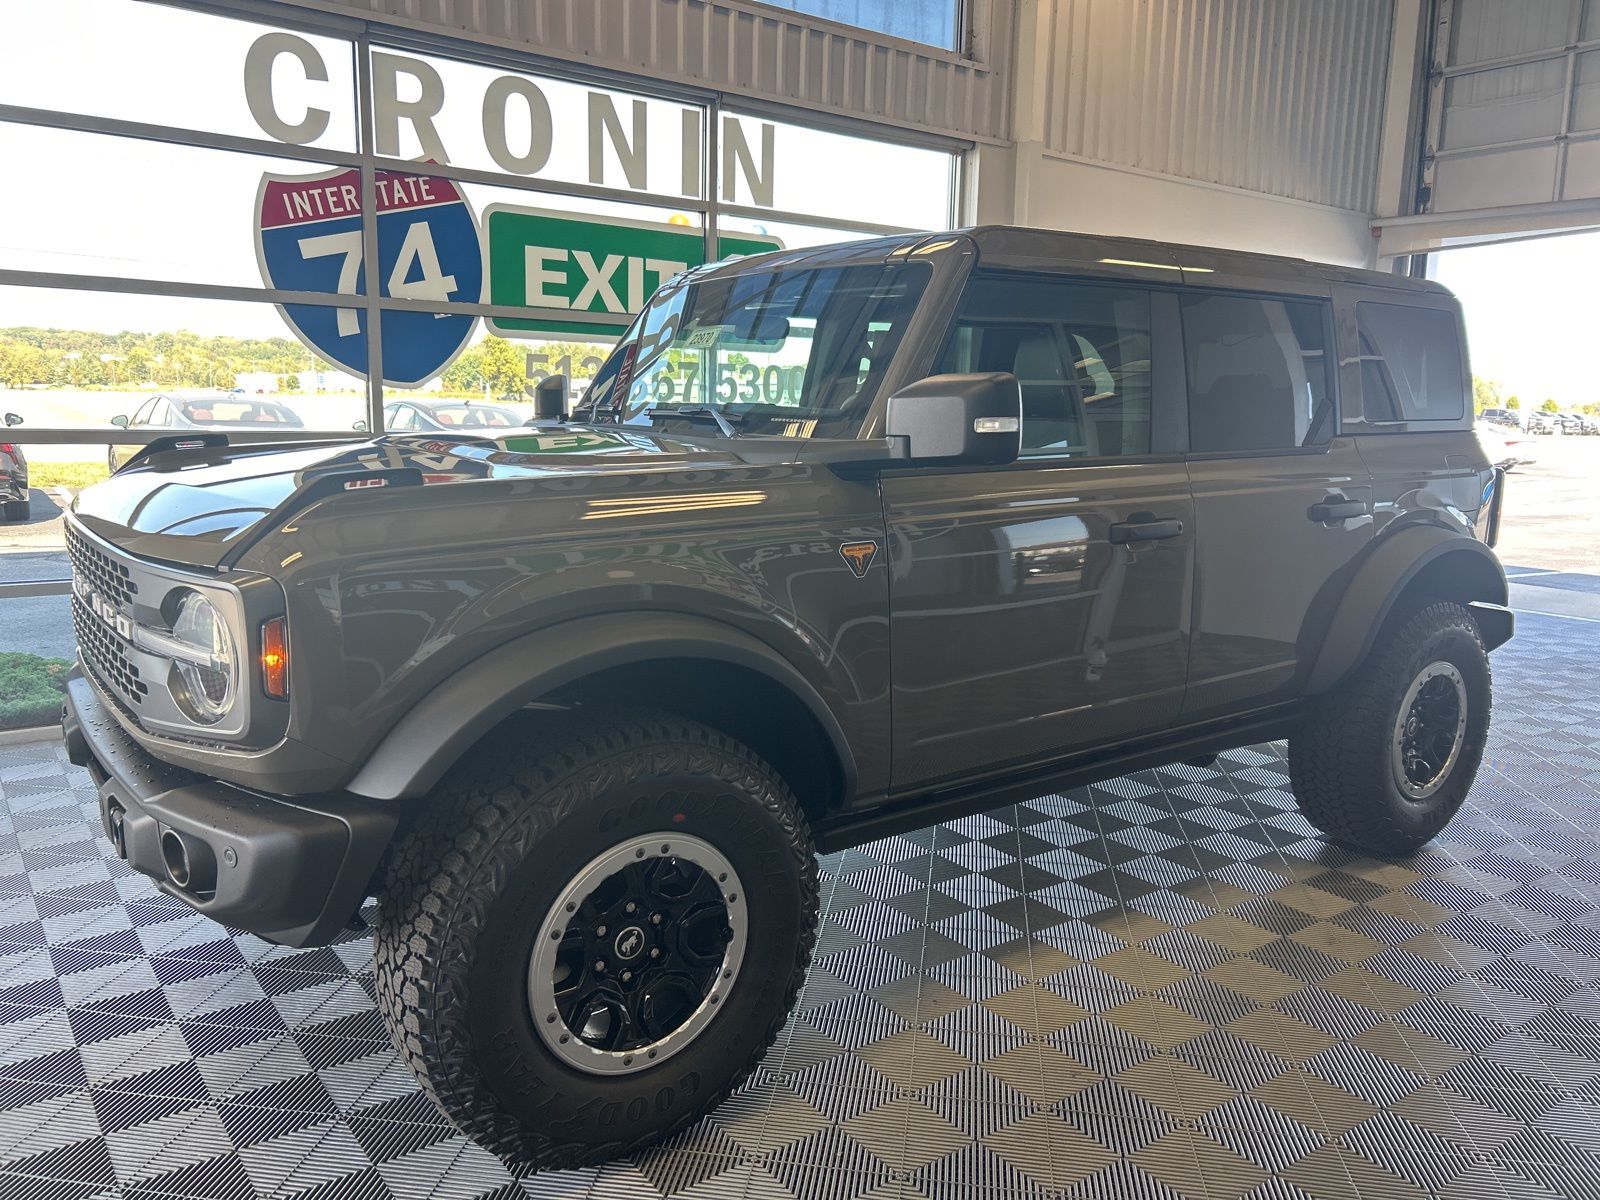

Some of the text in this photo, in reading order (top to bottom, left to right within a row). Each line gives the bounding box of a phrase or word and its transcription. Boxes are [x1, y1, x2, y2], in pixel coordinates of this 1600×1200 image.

[243, 32, 775, 207] CRONIN
[282, 176, 436, 220] INTERTATE
[297, 220, 459, 338] 74
[525, 245, 688, 314] EXIT
